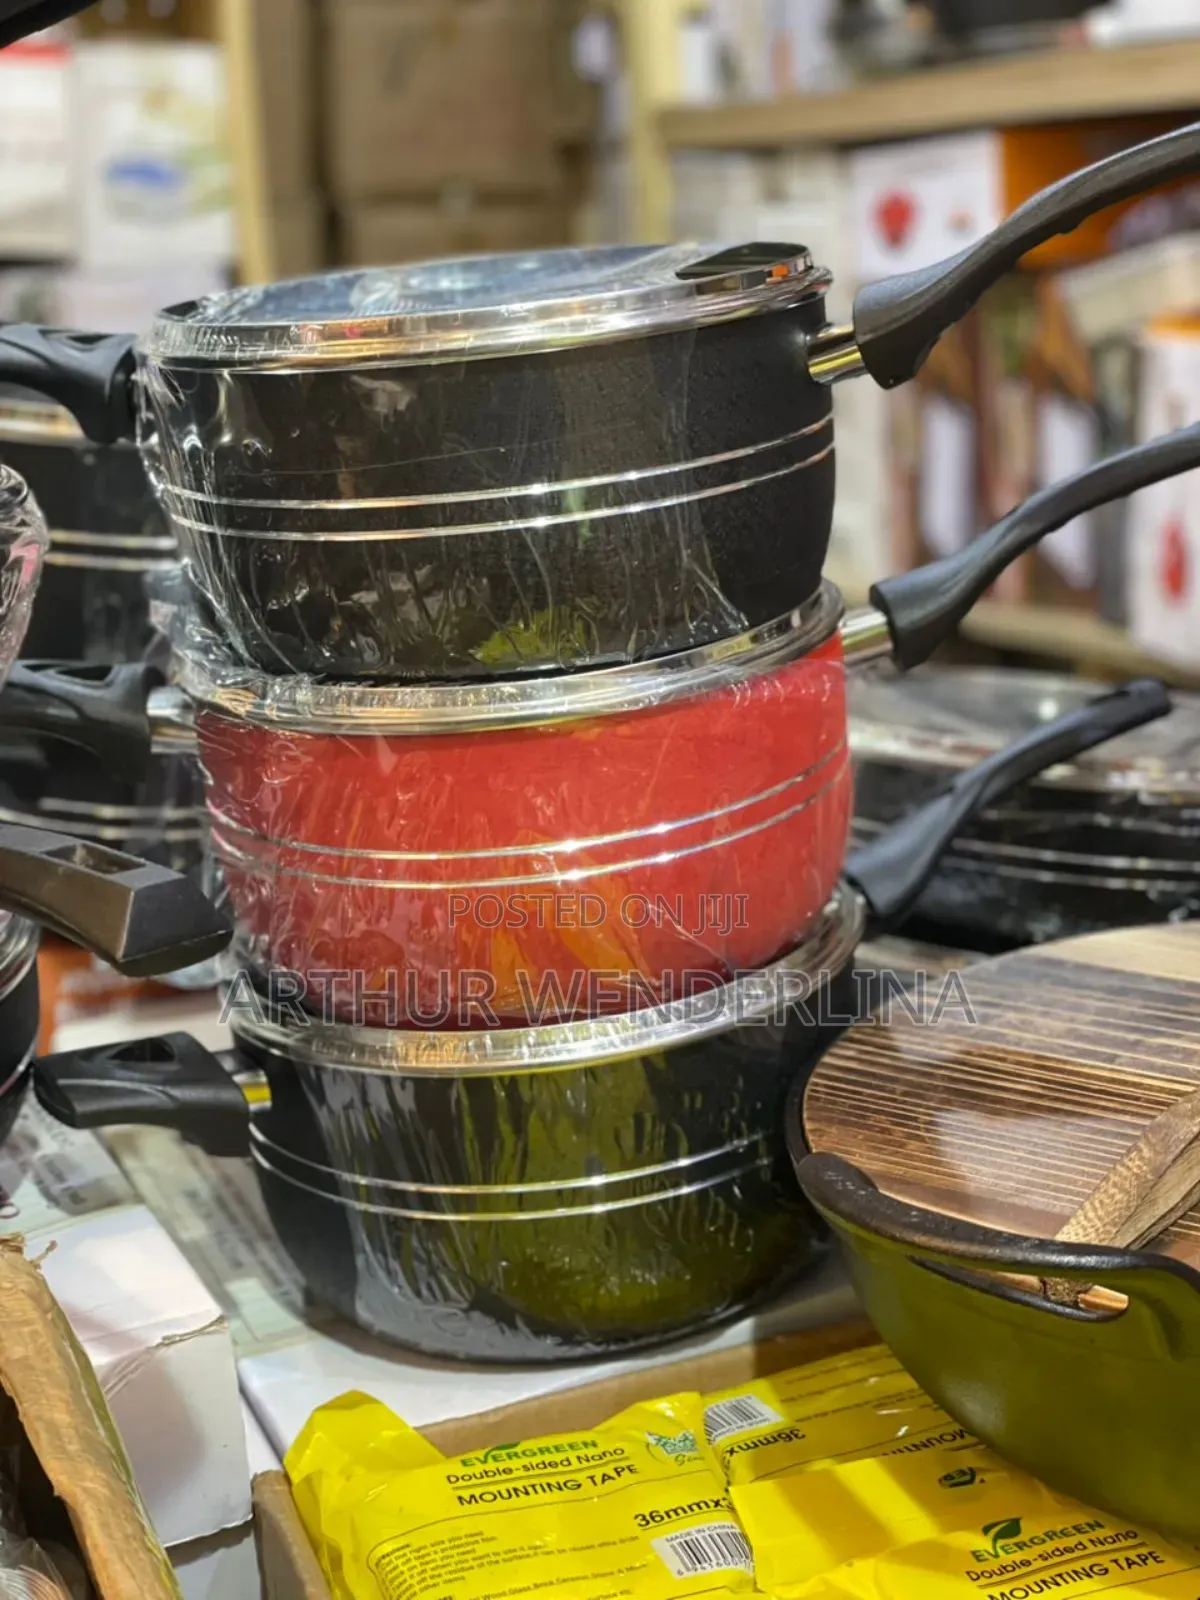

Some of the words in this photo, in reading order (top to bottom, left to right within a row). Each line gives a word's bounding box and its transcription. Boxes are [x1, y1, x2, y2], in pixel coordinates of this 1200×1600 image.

[445, 1457, 572, 1485] Double-sided
[576, 1448, 625, 1465] Nano
[460, 1440, 598, 1467] EVERGREEN
[456, 1478, 583, 1506] MOUNTING
[586, 1464, 639, 1487] TAPE
[965, 1542, 1087, 1582] Double-sided
[1088, 1529, 1139, 1548] Nano
[970, 1519, 1105, 1562] EVERGREEN
[987, 1562, 1110, 1600] MOUNTING
[1110, 1551, 1165, 1572] TAPE
